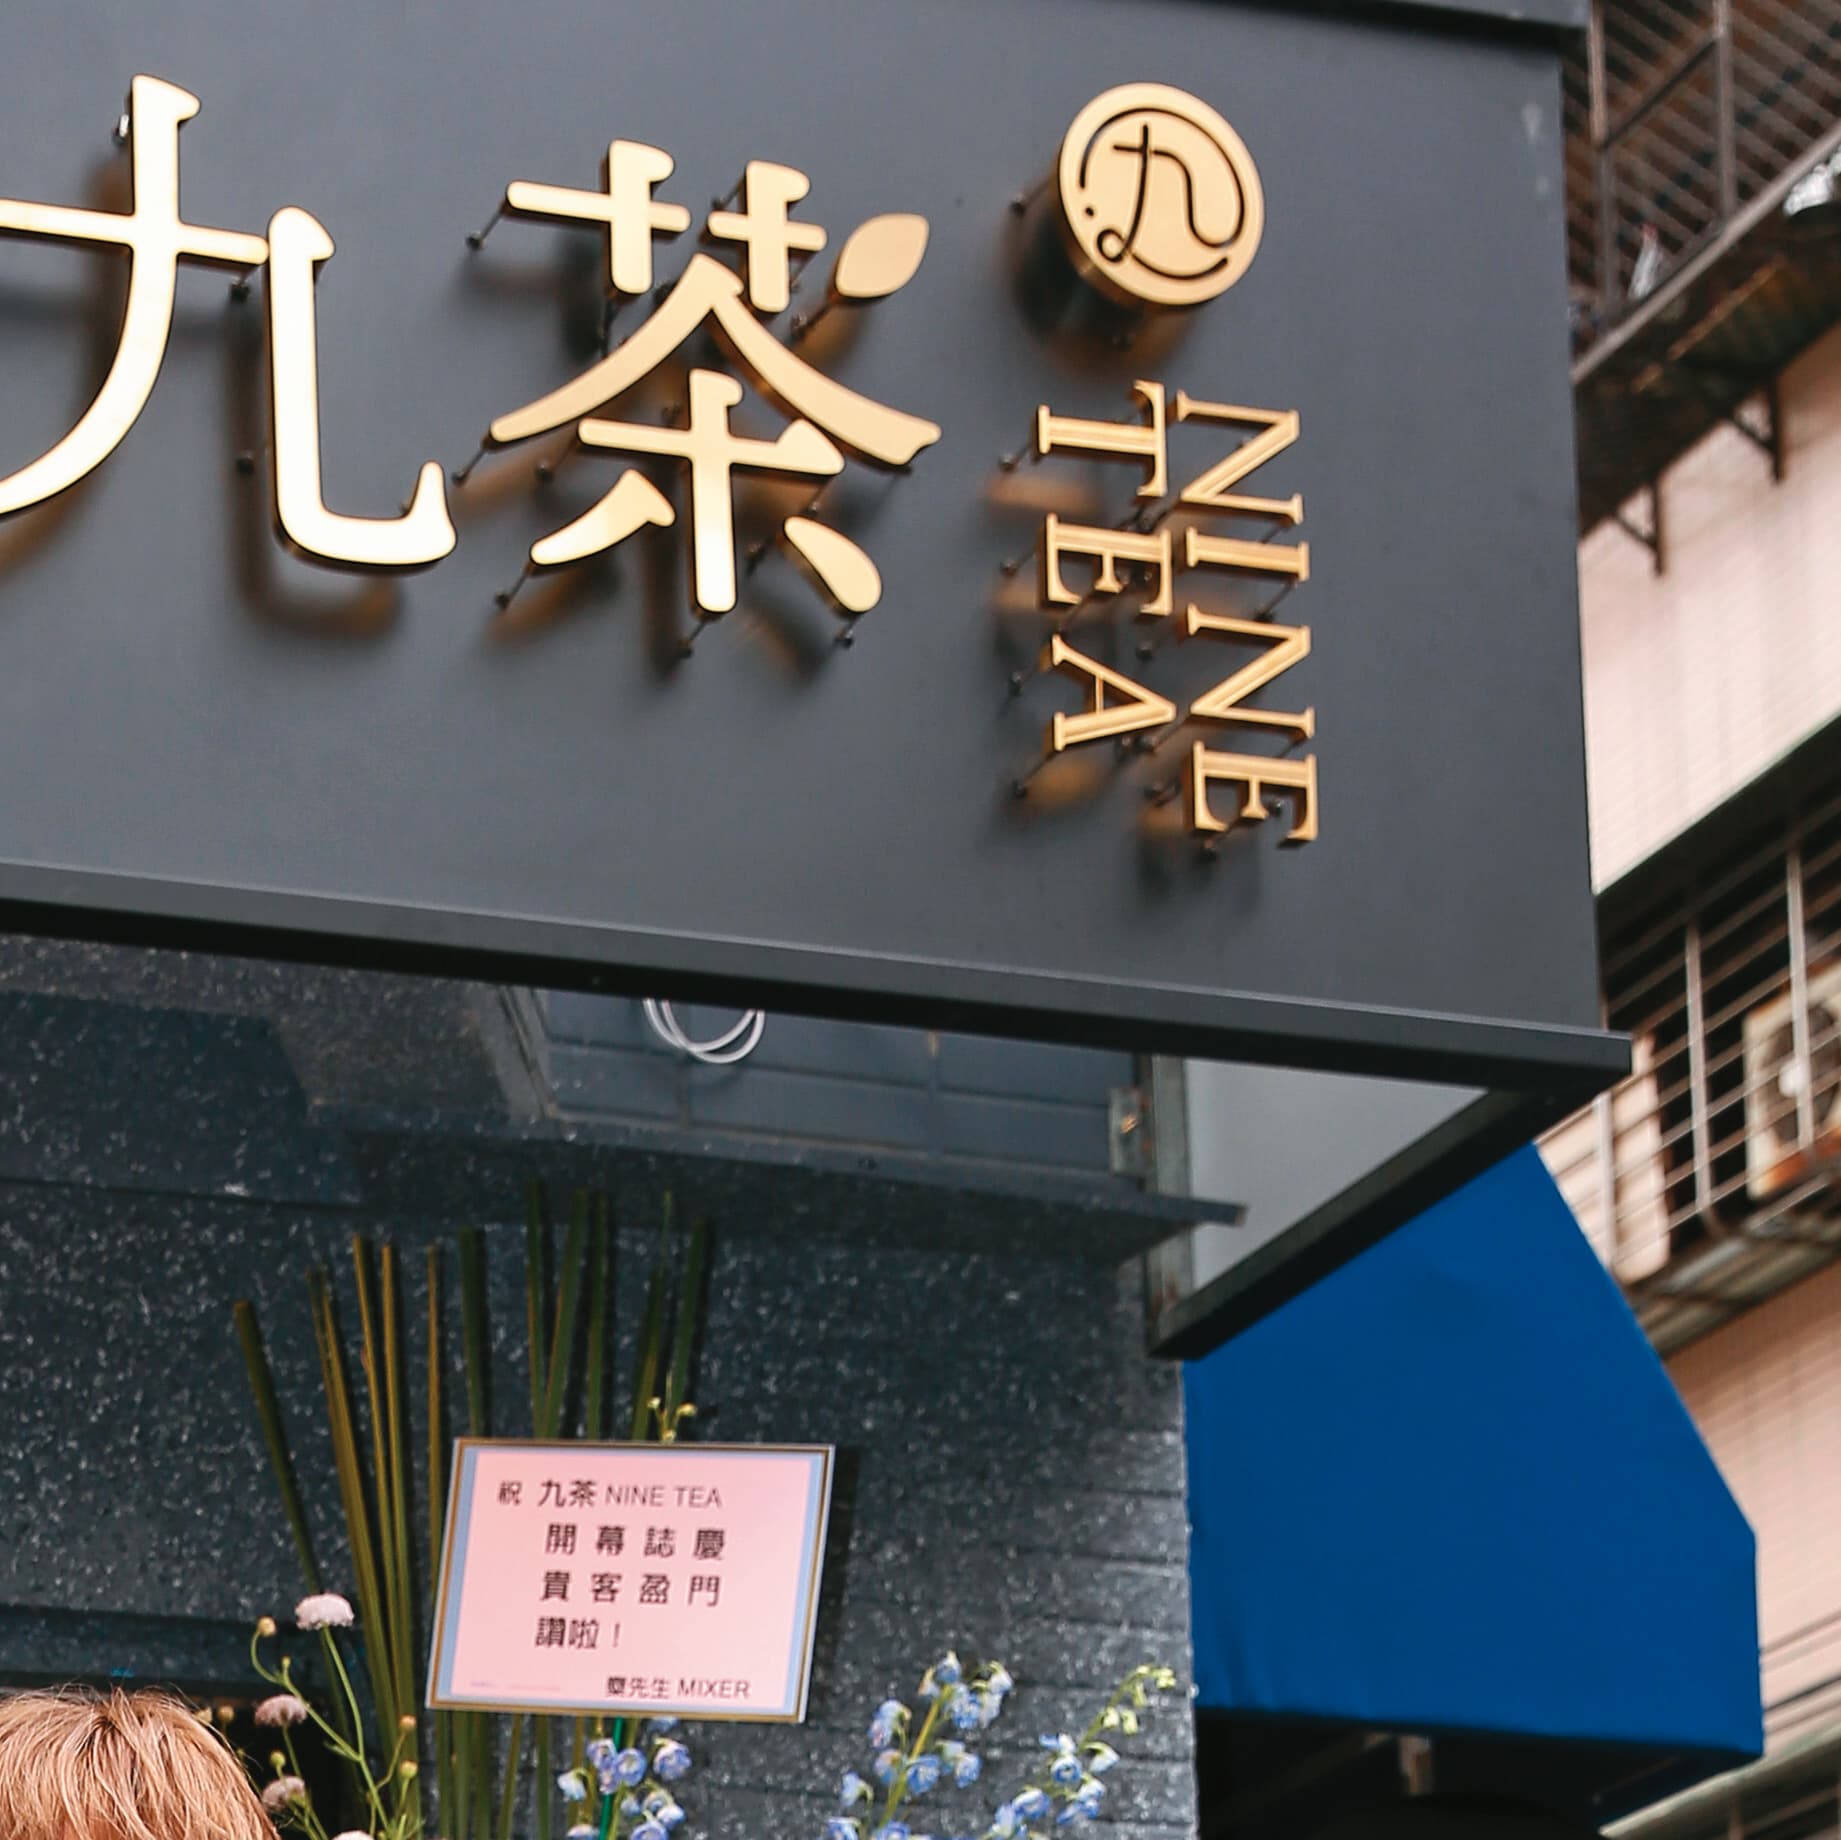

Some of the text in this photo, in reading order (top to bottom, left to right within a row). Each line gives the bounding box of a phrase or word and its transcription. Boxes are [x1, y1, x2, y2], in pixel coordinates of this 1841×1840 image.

[1036, 379, 1179, 754] TEA
[1173, 388, 1320, 848] NINE
[537, 1478, 598, 1509] 九茶
[604, 1485, 665, 1508] NINE
[674, 1486, 723, 1510] TEA
[678, 1677, 752, 1701] MIXER
